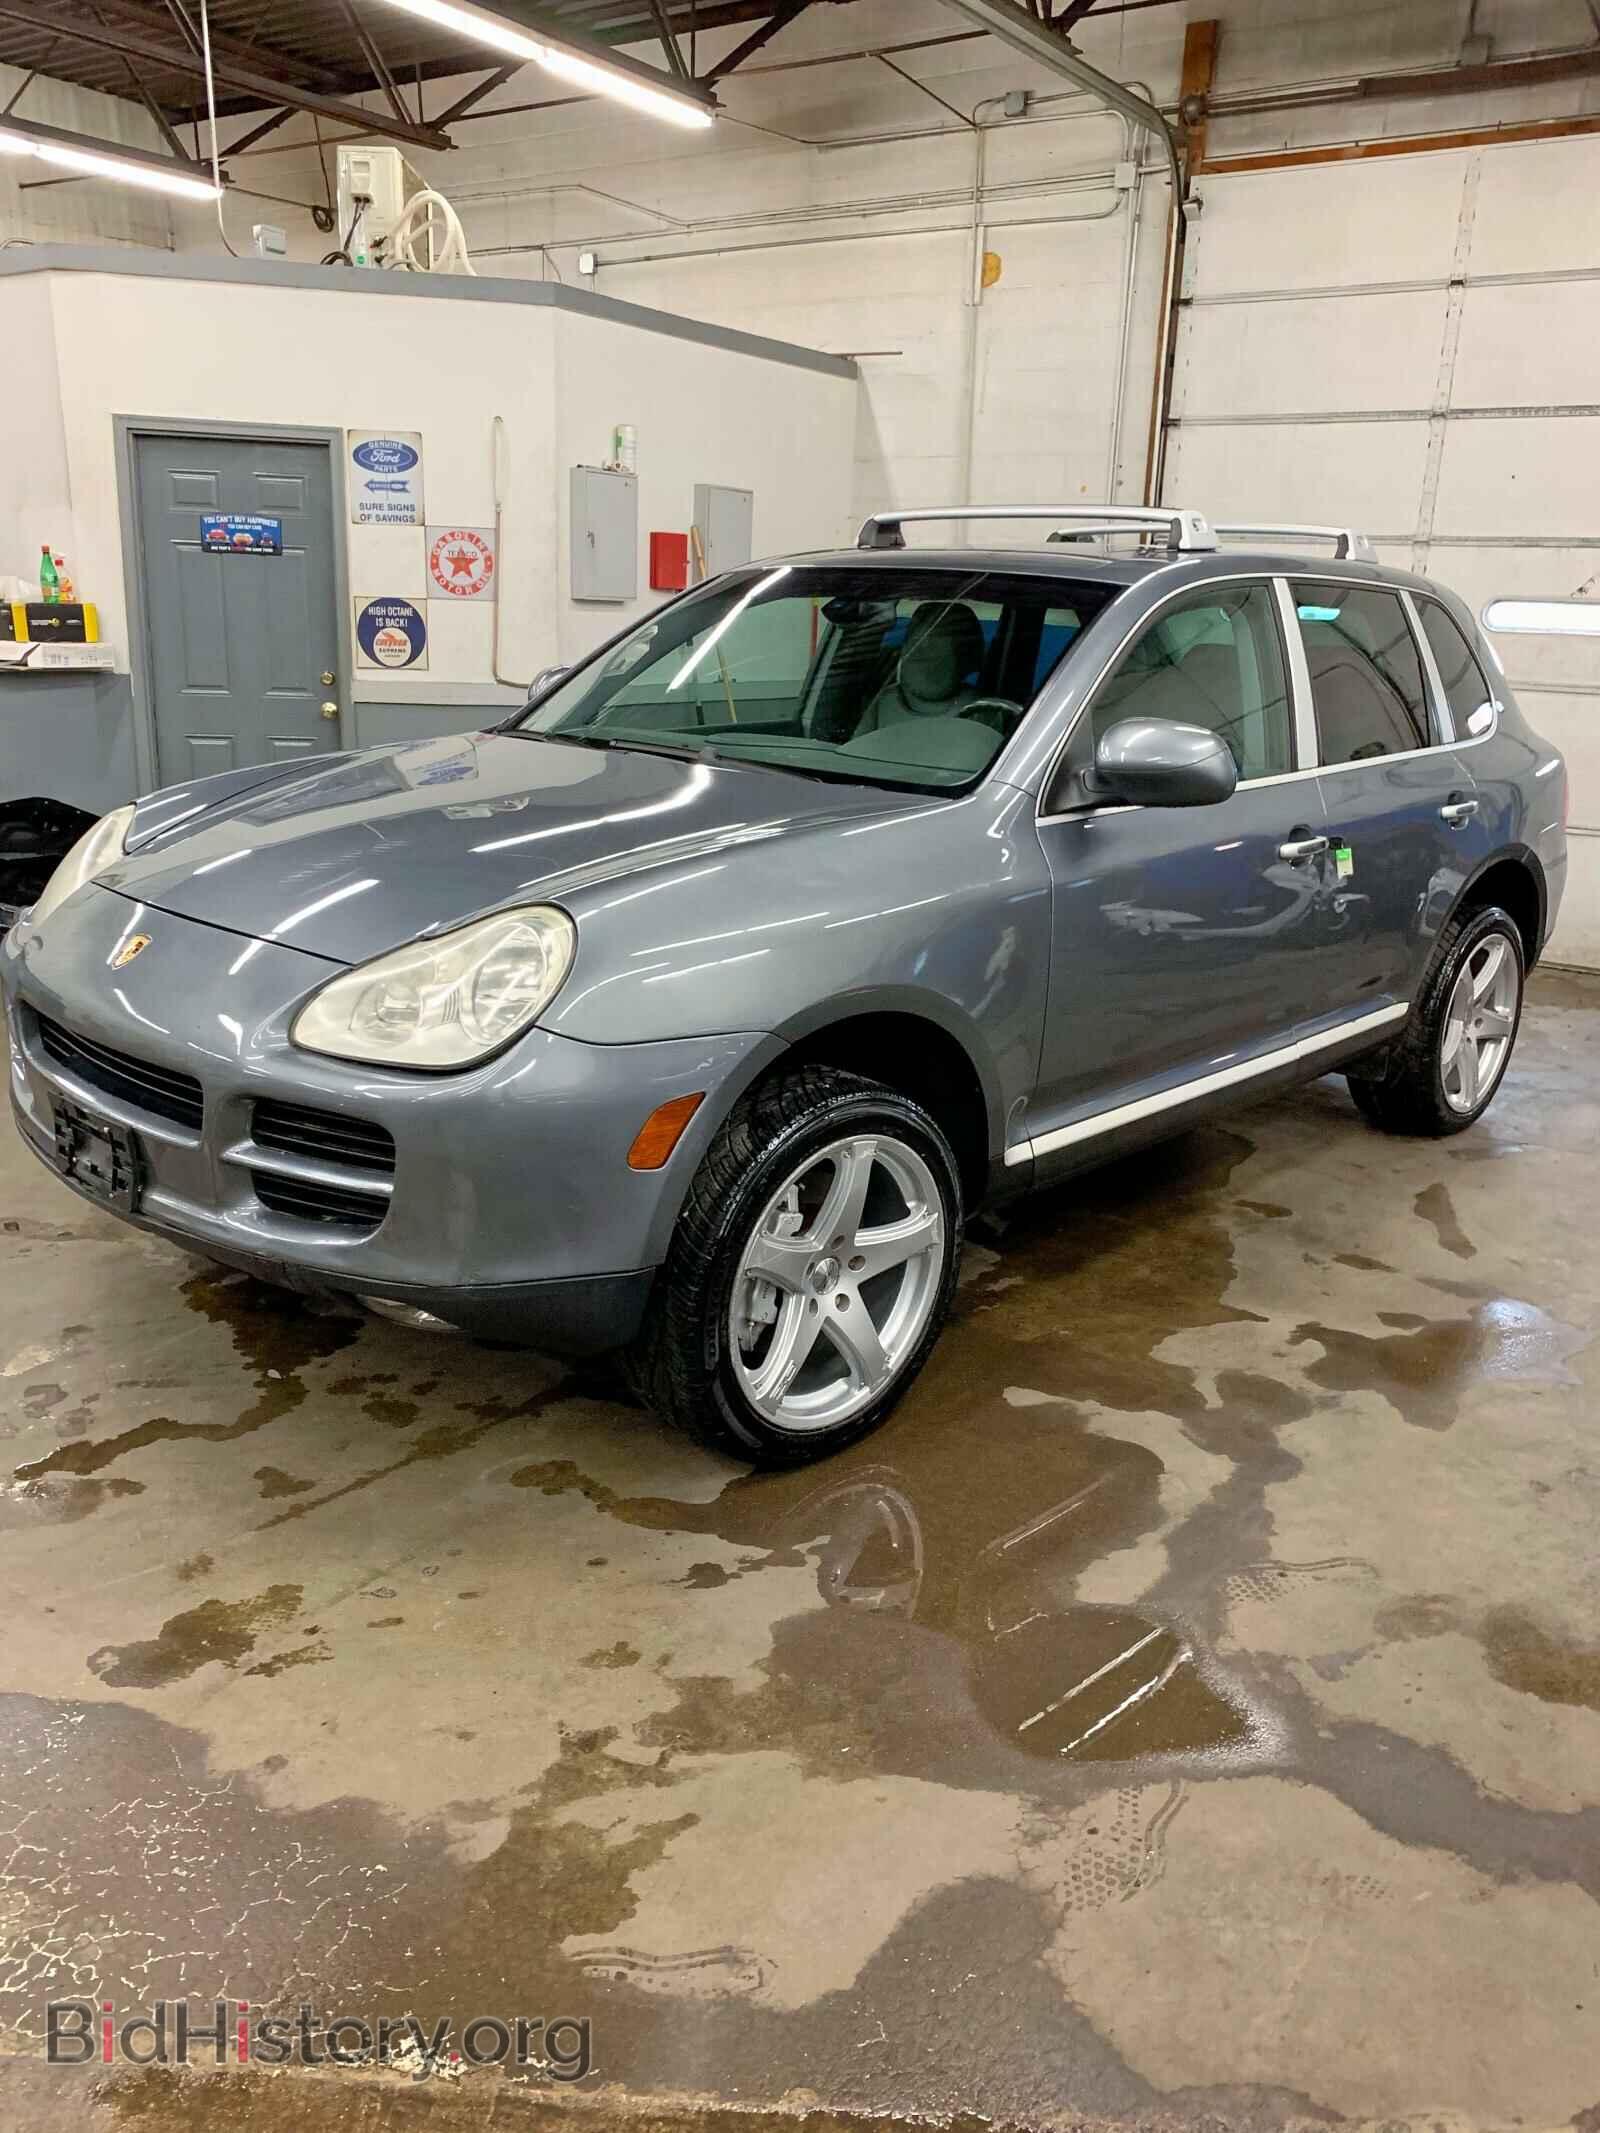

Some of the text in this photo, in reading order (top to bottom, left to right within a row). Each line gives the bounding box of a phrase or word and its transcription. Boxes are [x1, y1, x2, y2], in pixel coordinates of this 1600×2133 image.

[368, 440, 403, 449] GENUINE
[370, 448, 401, 463] Ford
[374, 465, 399, 473] PARTS
[359, 502, 416, 512] SURE SIGNS
[360, 513, 416, 523] OF SAVINGS
[368, 606, 414, 617] HIGH OCTANE
[375, 617, 408, 627] IS BACK!
